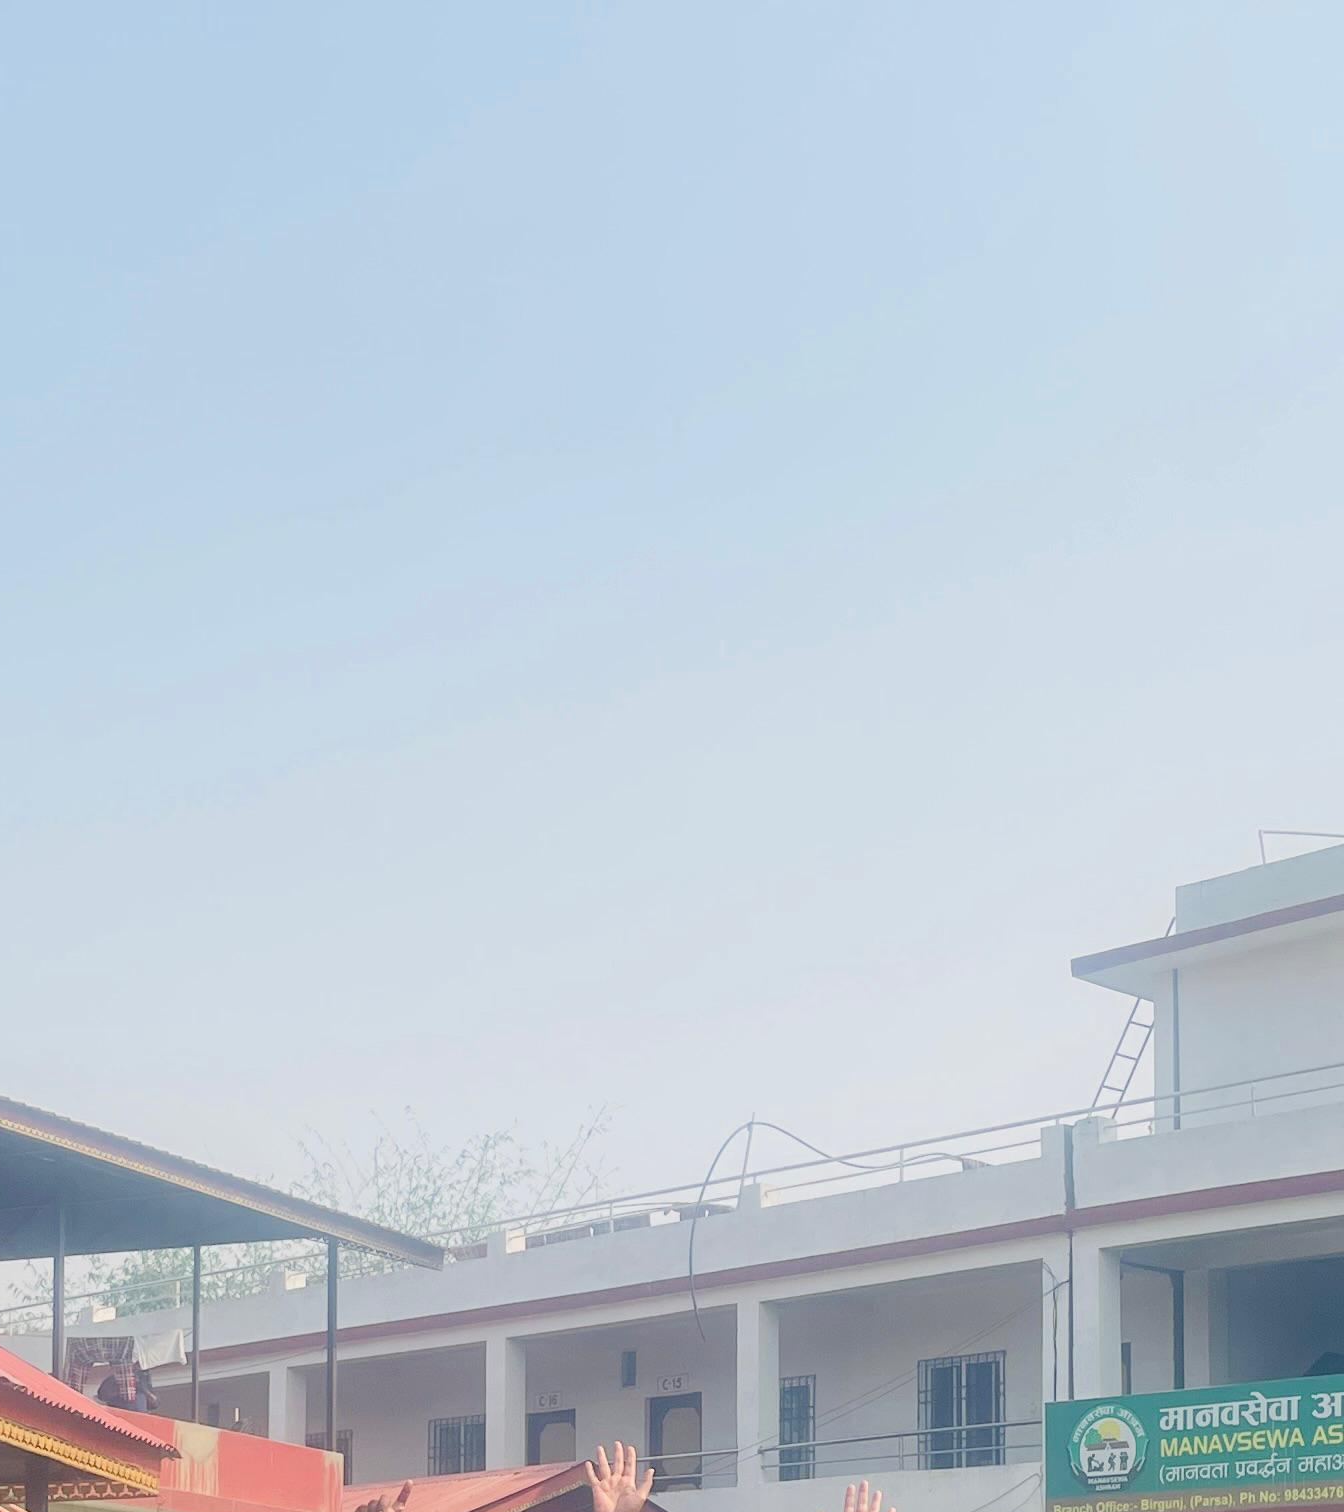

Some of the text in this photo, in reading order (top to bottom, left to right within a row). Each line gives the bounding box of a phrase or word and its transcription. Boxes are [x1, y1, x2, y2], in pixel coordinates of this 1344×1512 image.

[1159, 1391, 1301, 1431] मानवसेवा
[1160, 1427, 1305, 1458] MANAVSEWA
[1159, 1463, 1230, 1485] (मानवता
[1239, 1491, 1256, 1504] Ph
